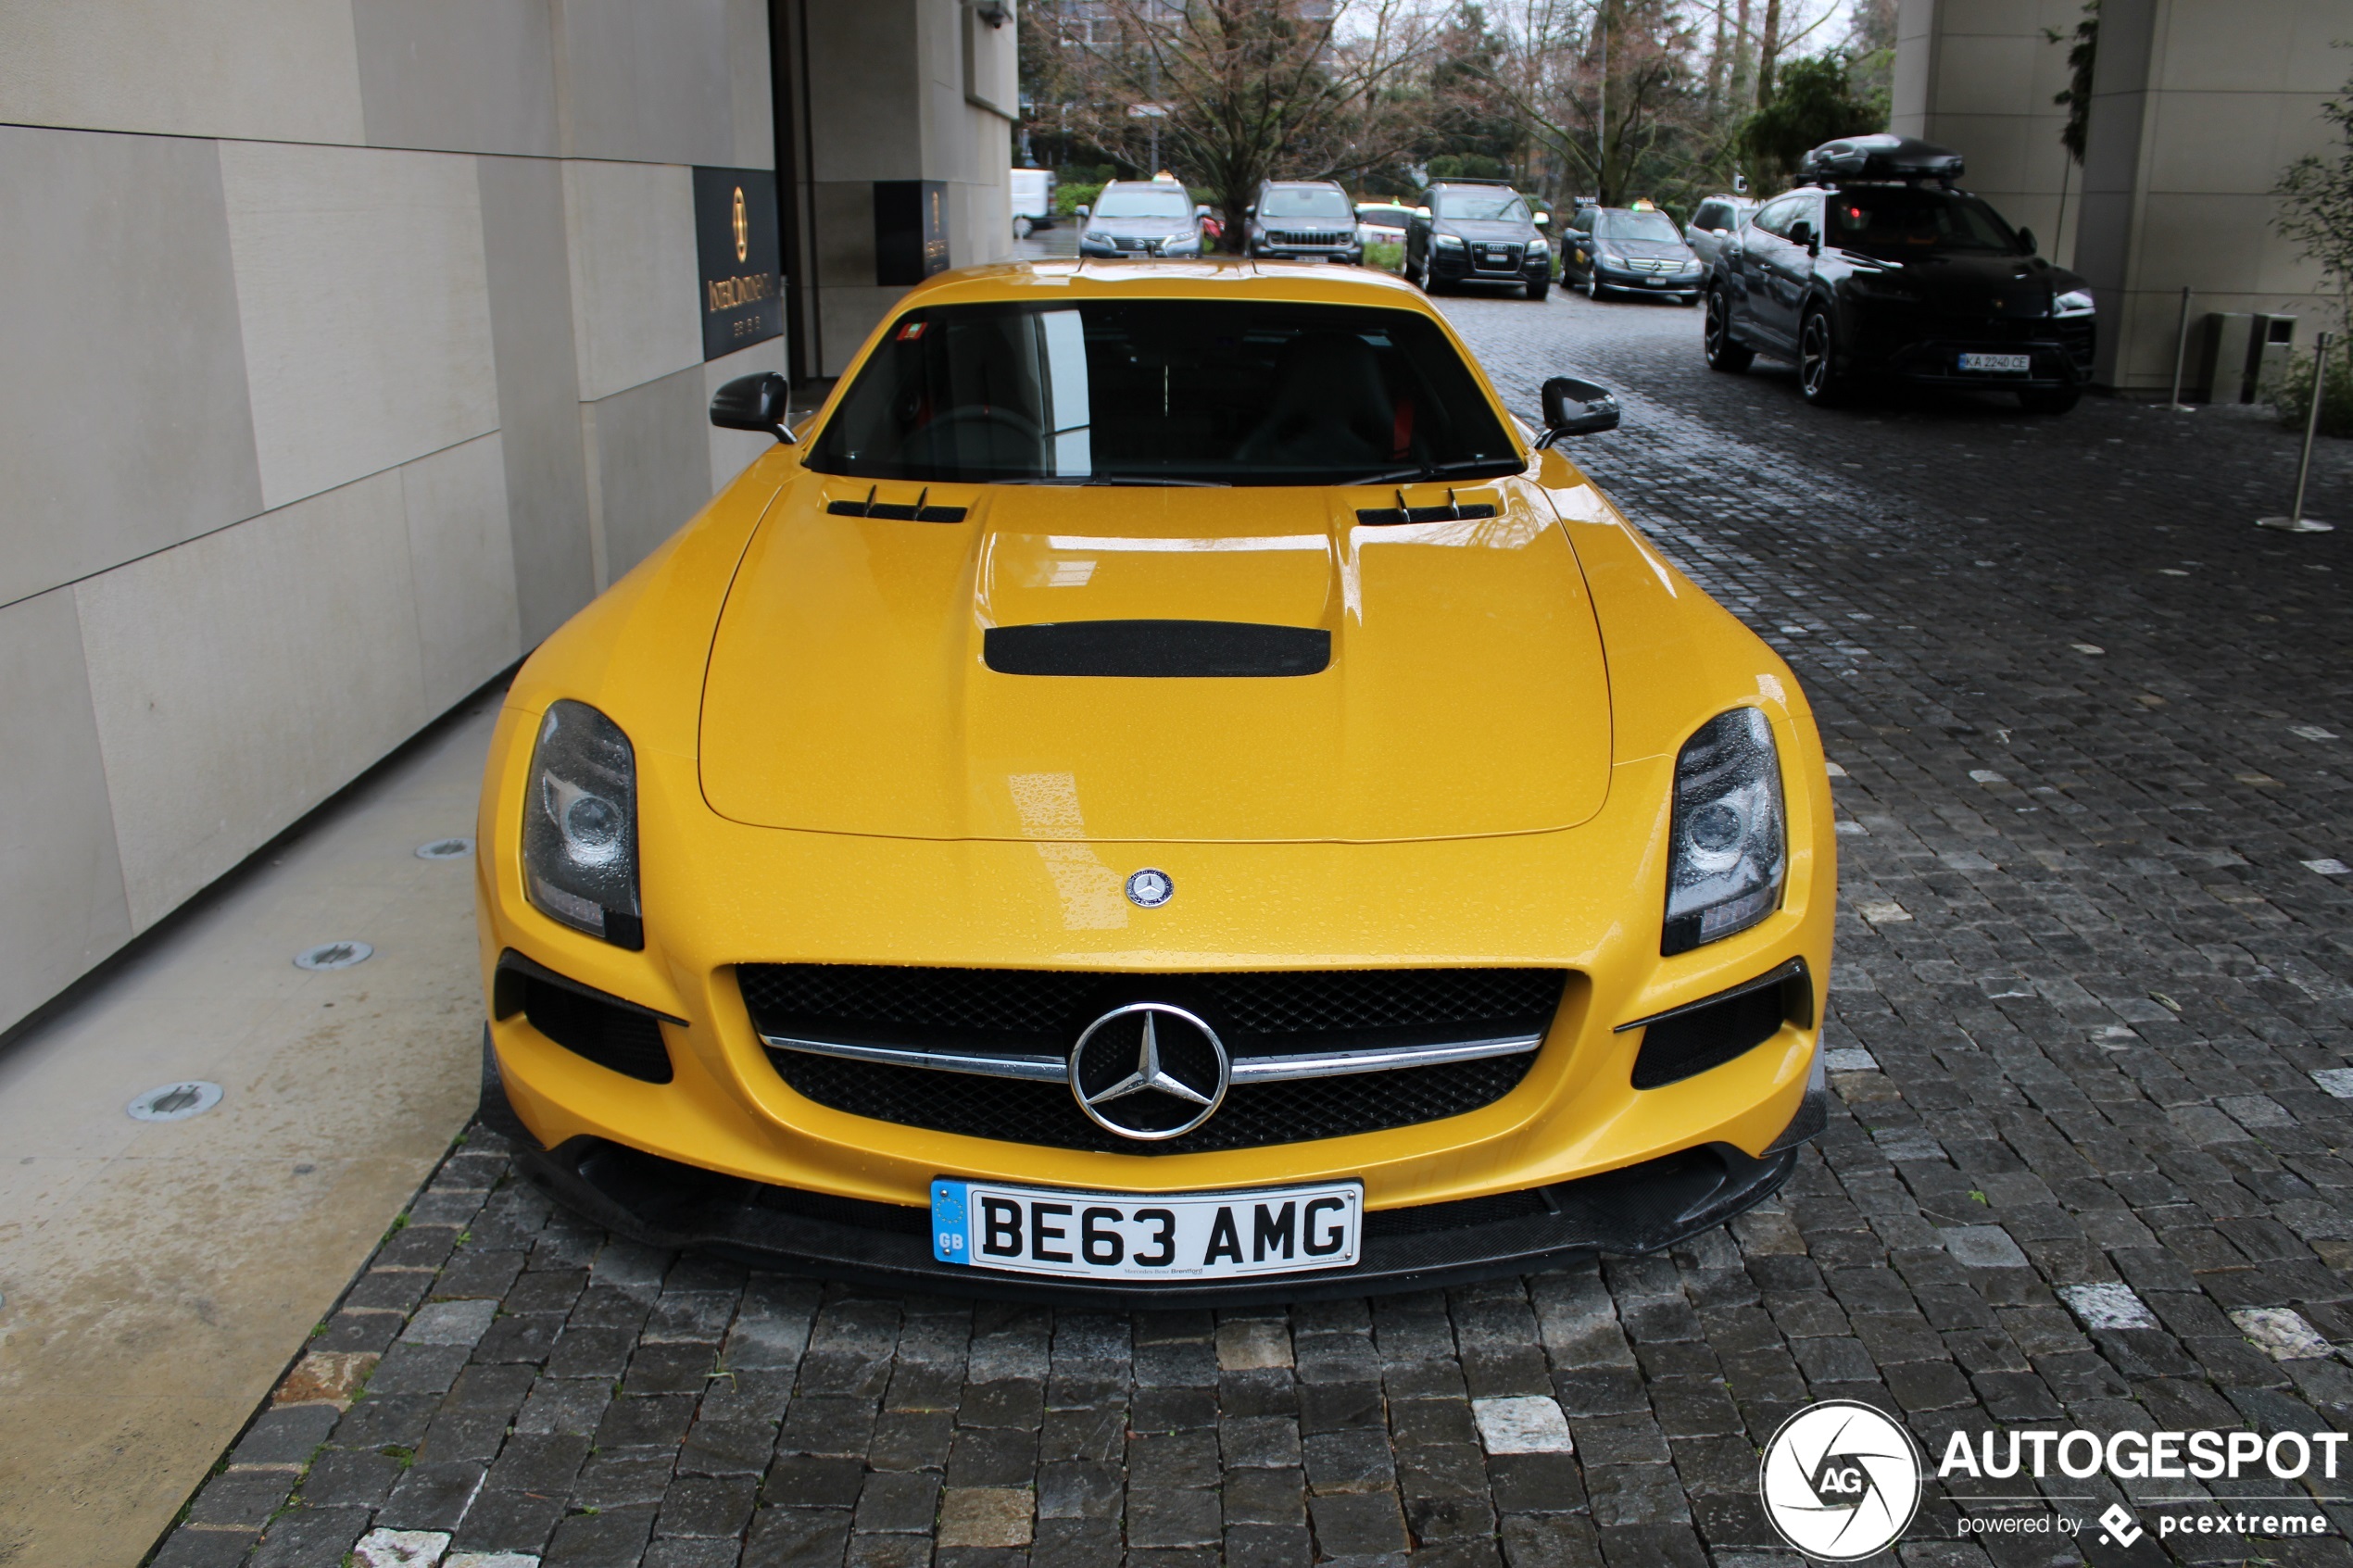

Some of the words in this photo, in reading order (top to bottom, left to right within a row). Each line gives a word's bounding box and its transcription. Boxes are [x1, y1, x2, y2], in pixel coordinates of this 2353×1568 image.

[1966, 357, 1982, 367] KA
[1984, 357, 2010, 368] 2240
[2012, 358, 2027, 368] CE
[981, 1197, 1176, 1267] BE63
[1203, 1197, 1345, 1266] AMG
[939, 1233, 963, 1250] GB
